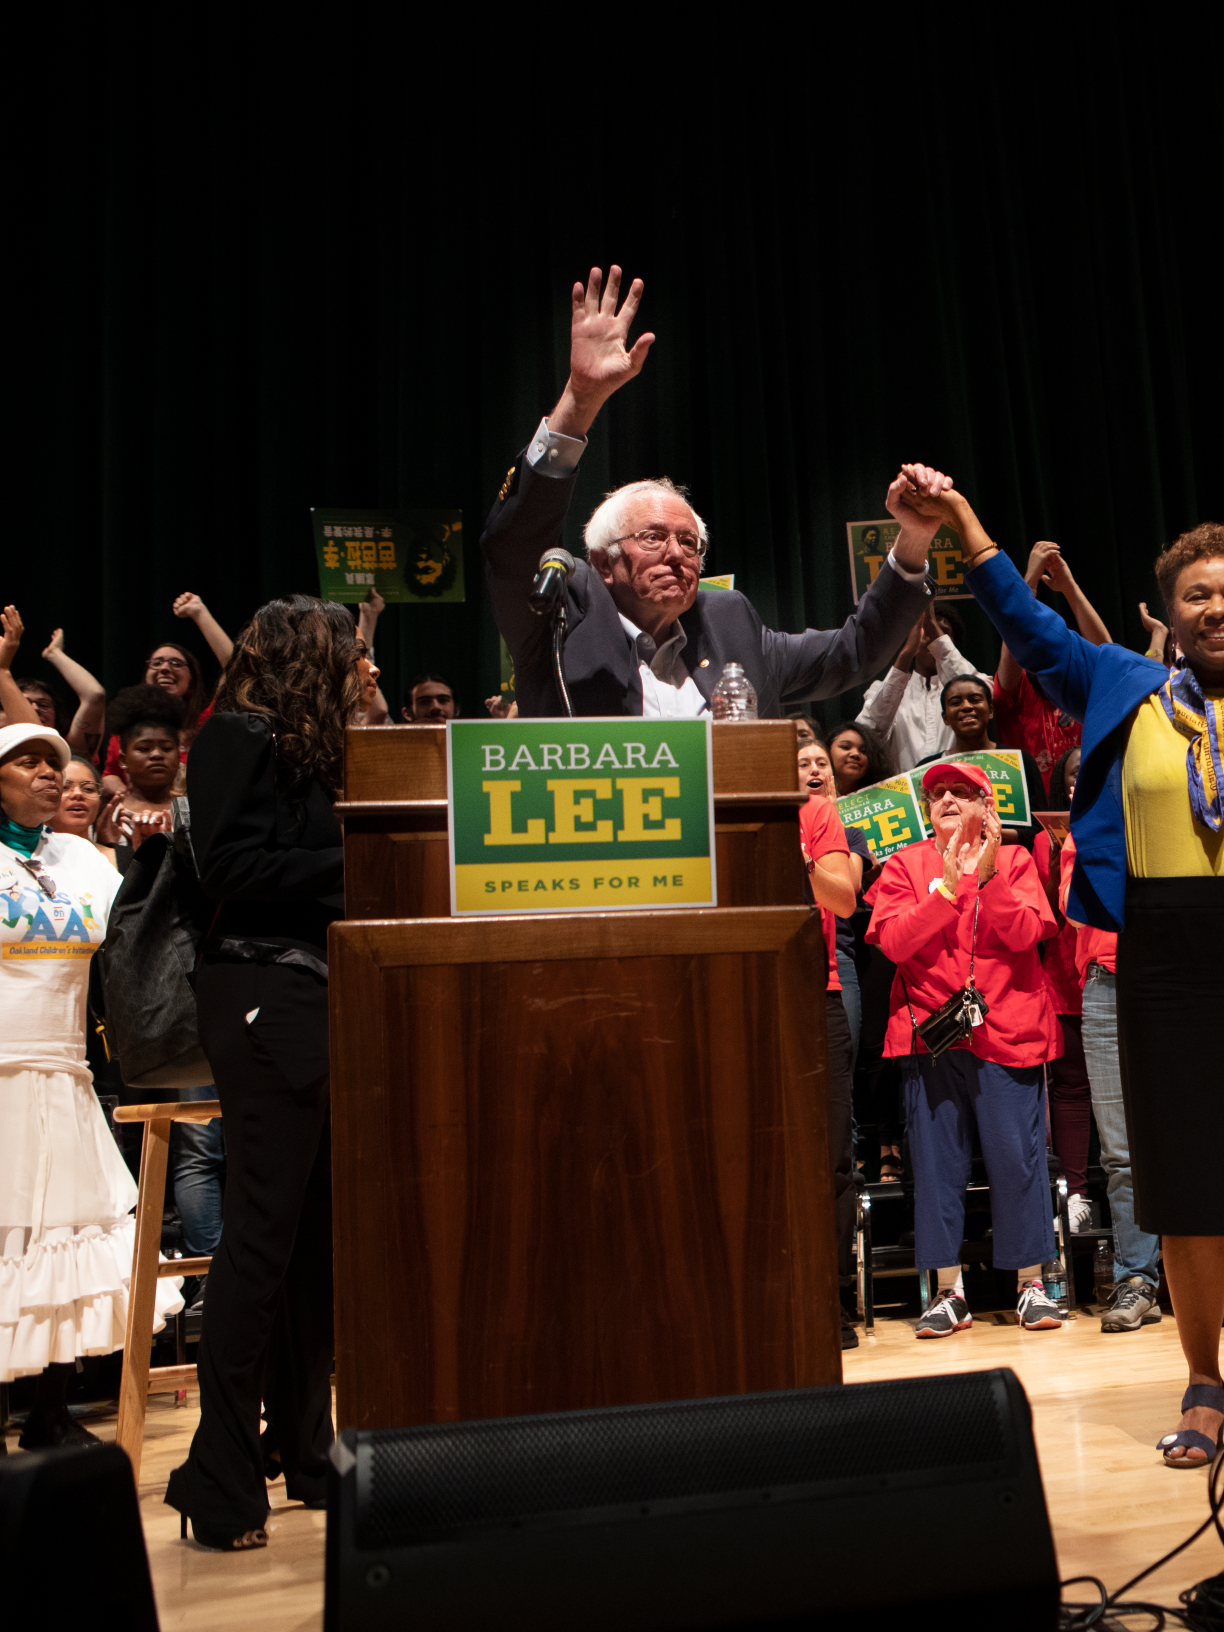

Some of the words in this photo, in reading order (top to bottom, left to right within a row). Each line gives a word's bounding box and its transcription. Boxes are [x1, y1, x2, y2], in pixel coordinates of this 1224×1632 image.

[323, 540, 397, 570] 芭芭拉·李
[481, 742, 680, 771] BARBARA
[482, 777, 682, 846] LEE
[884, 846, 895, 854] for
[484, 878, 581, 893] SPEAKS
[593, 876, 640, 889] FOR
[653, 875, 684, 887] ME
[21, 906, 91, 943] AA
[9, 946, 39, 955] Oakland
[40, 945, 71, 955] Children's
